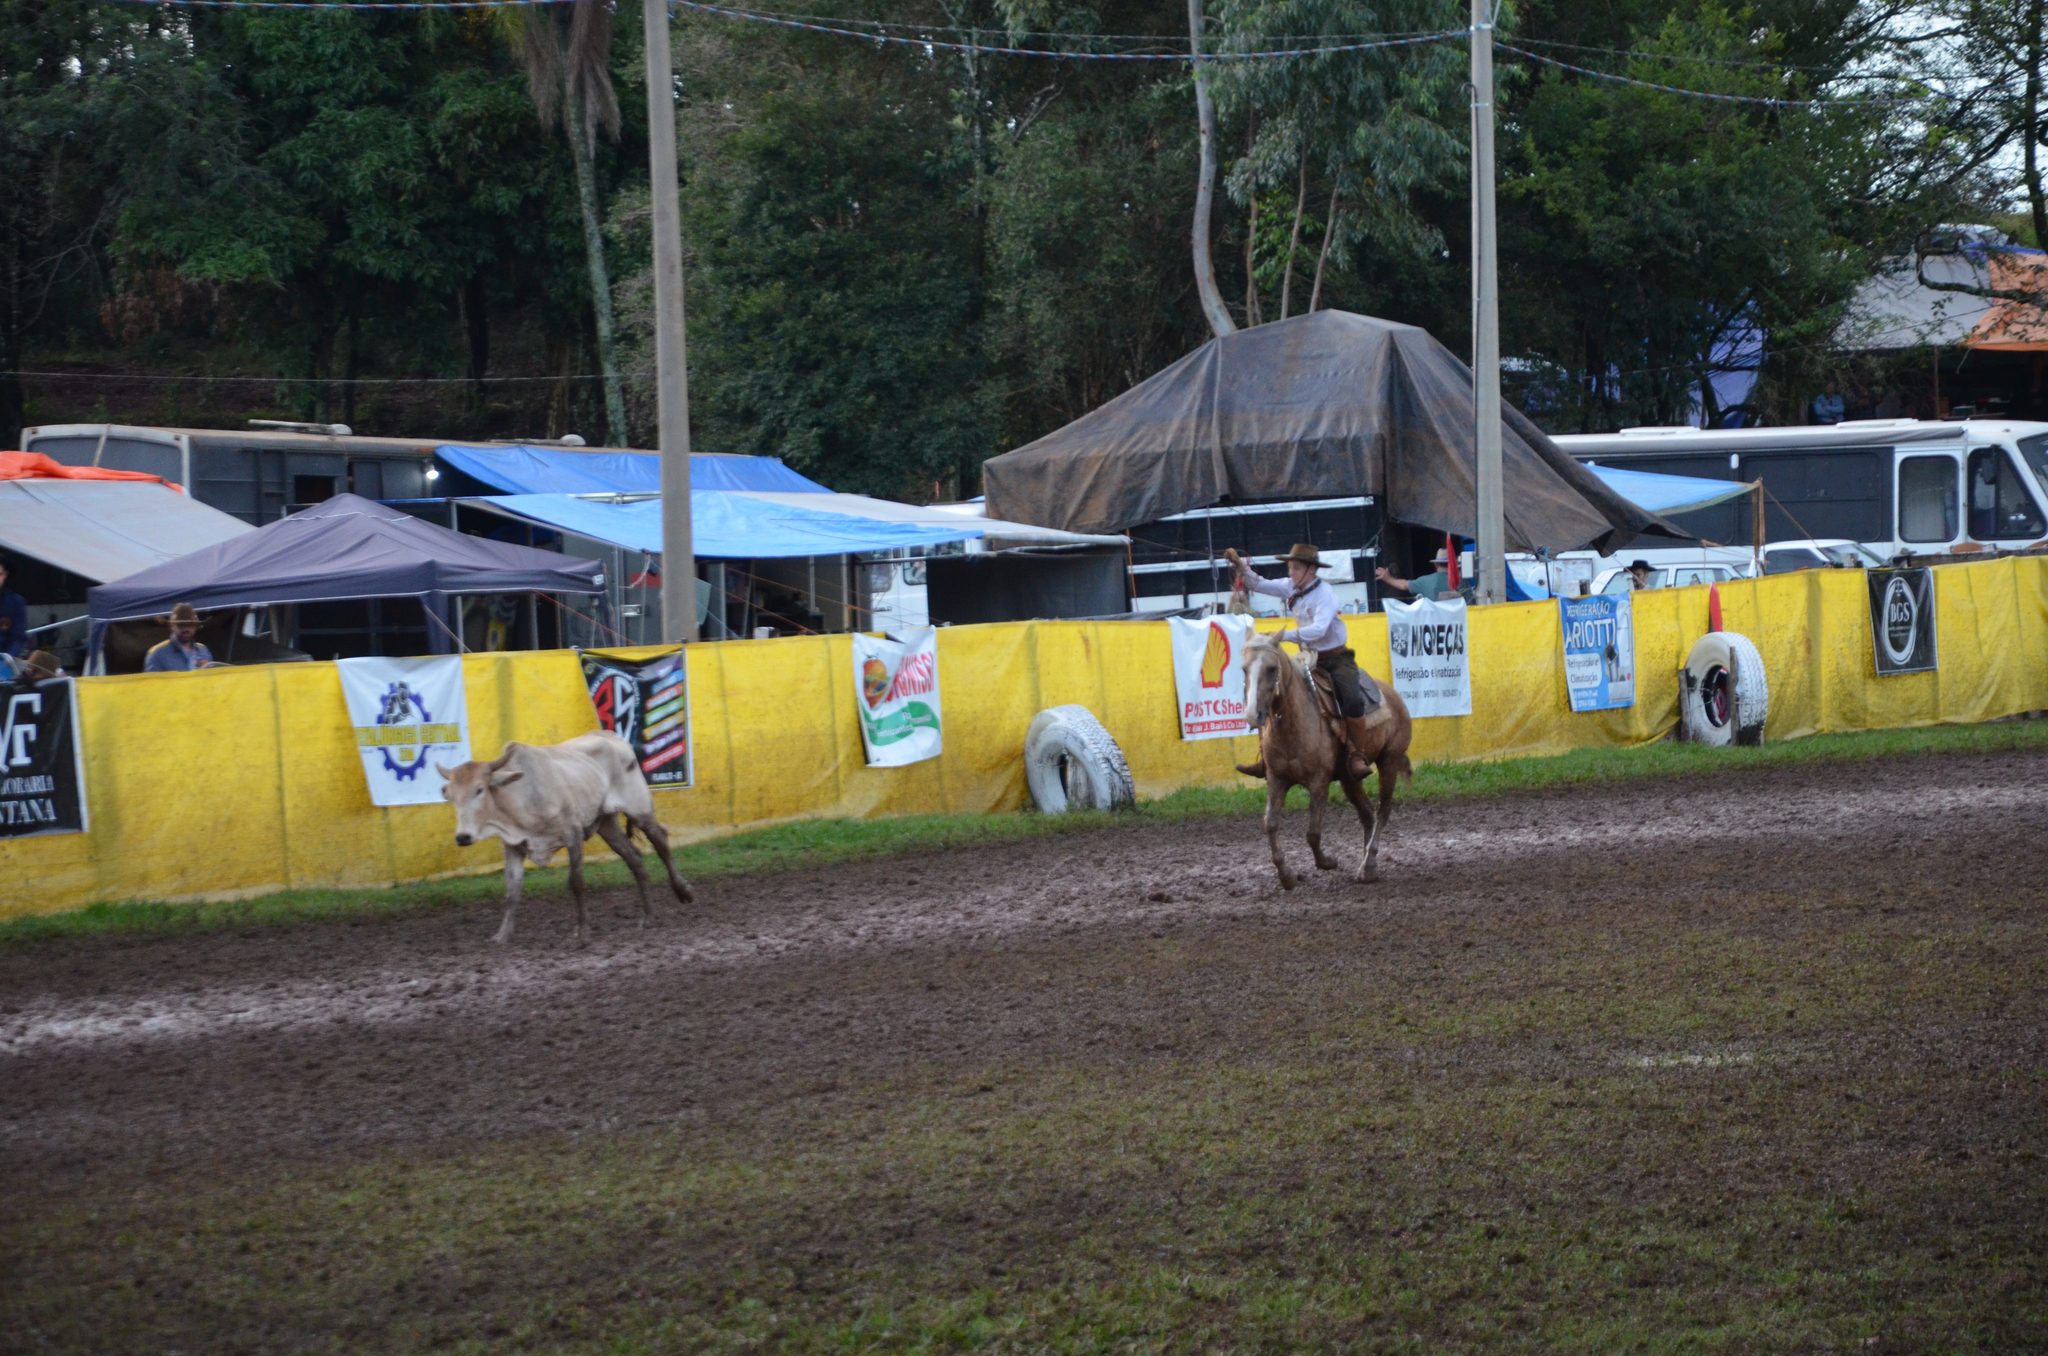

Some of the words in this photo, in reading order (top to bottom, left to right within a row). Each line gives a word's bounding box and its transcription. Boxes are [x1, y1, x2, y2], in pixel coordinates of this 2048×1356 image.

[1566, 600, 1610, 618] REFRIGERAÇÃO
[1890, 602, 1910, 623] BGS
[1565, 618, 1616, 650] ARIOTTI
[1222, 697, 1246, 715] Shel
